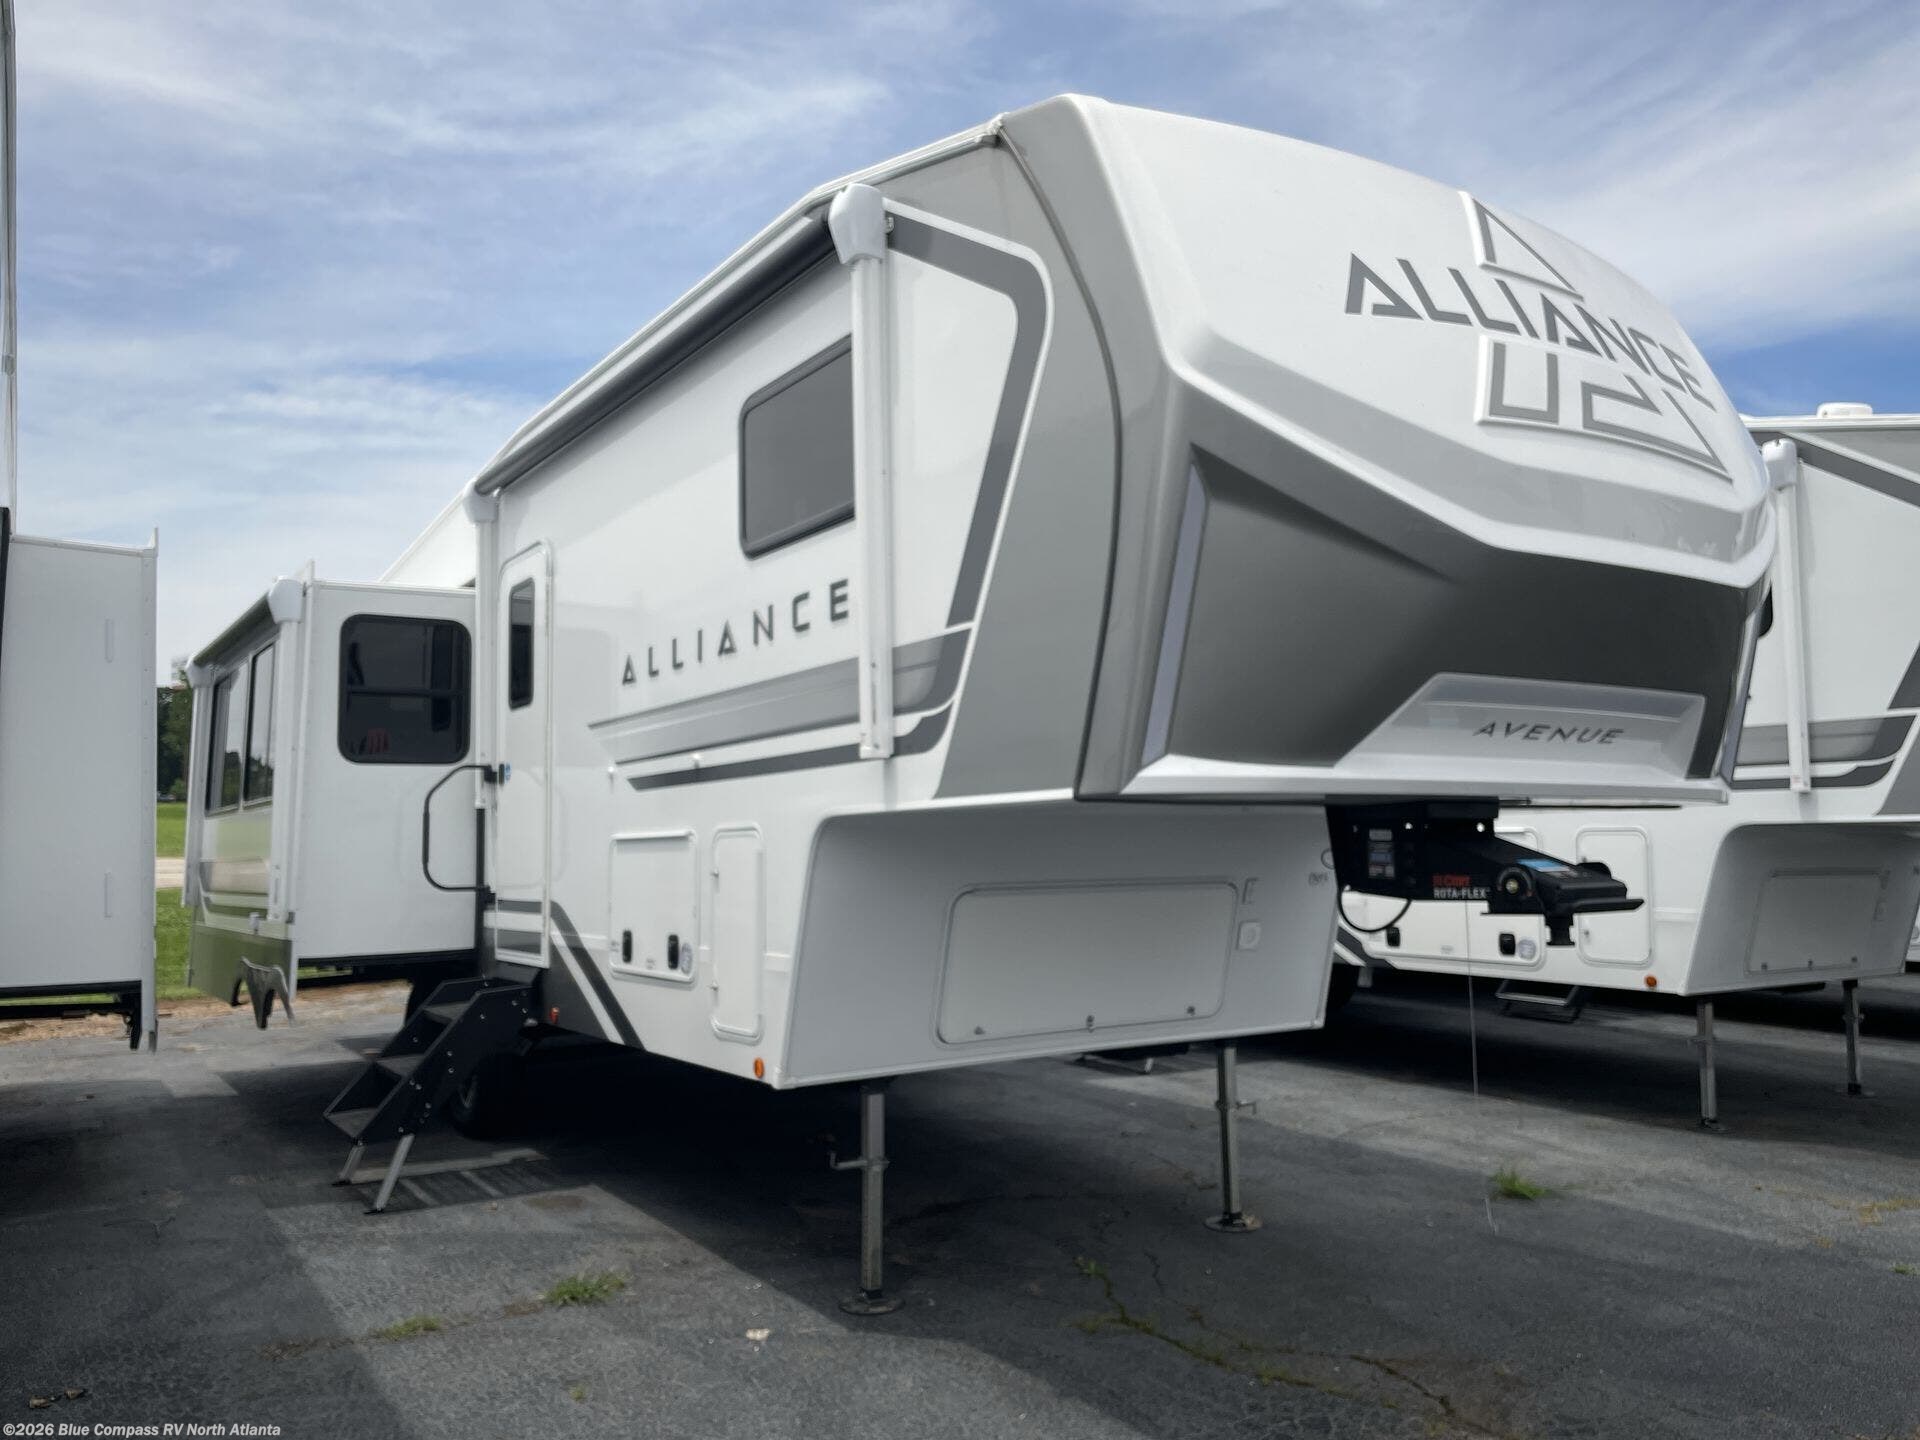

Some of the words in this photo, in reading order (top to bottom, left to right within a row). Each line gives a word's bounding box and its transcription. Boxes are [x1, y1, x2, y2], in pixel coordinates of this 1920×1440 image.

[1344, 252, 1717, 412] ALLIANCE
[621, 578, 849, 686] ALLIANCE
[1473, 721, 1624, 745] AVENUE
